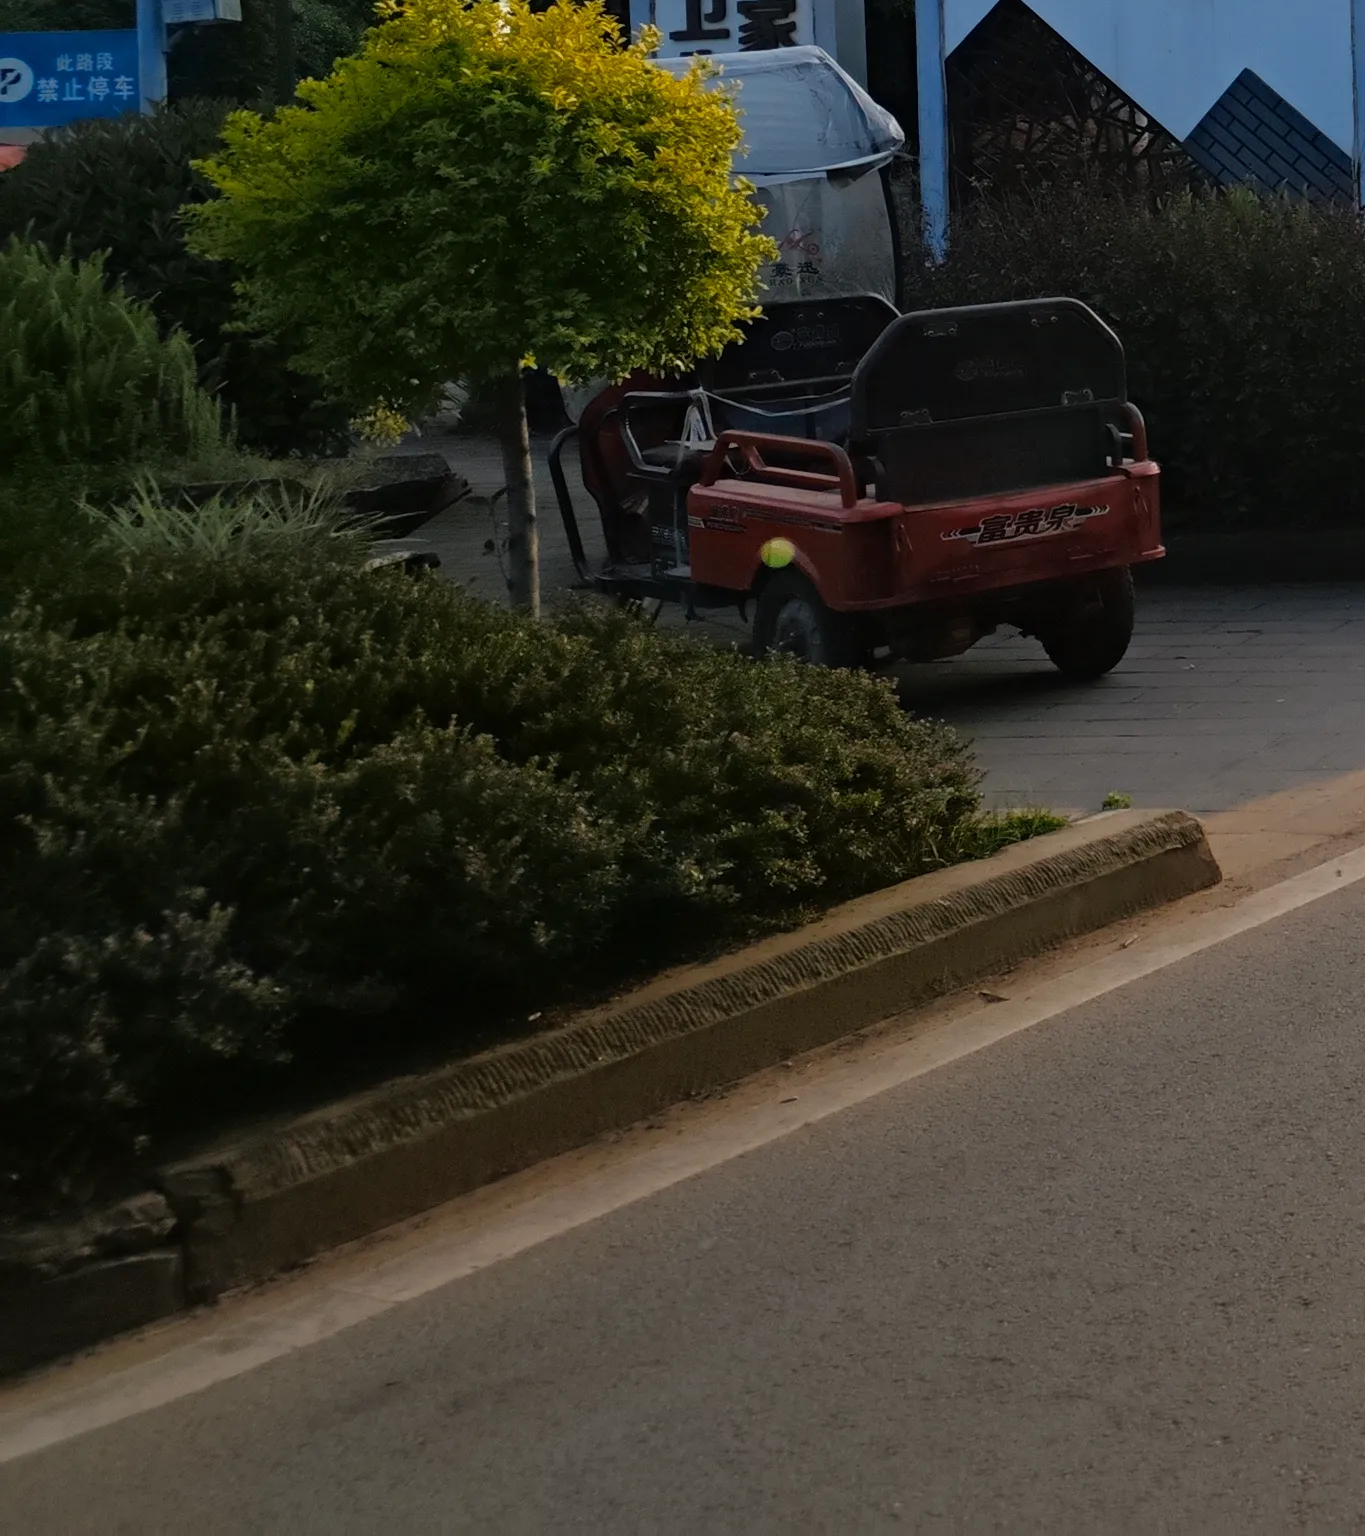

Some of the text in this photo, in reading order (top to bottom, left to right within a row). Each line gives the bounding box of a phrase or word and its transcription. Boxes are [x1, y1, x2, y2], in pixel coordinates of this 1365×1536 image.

[56, 52, 114, 73] 此路段
[37, 75, 135, 103] 禁止停车
[976, 503, 1078, 544] 富贵泉
